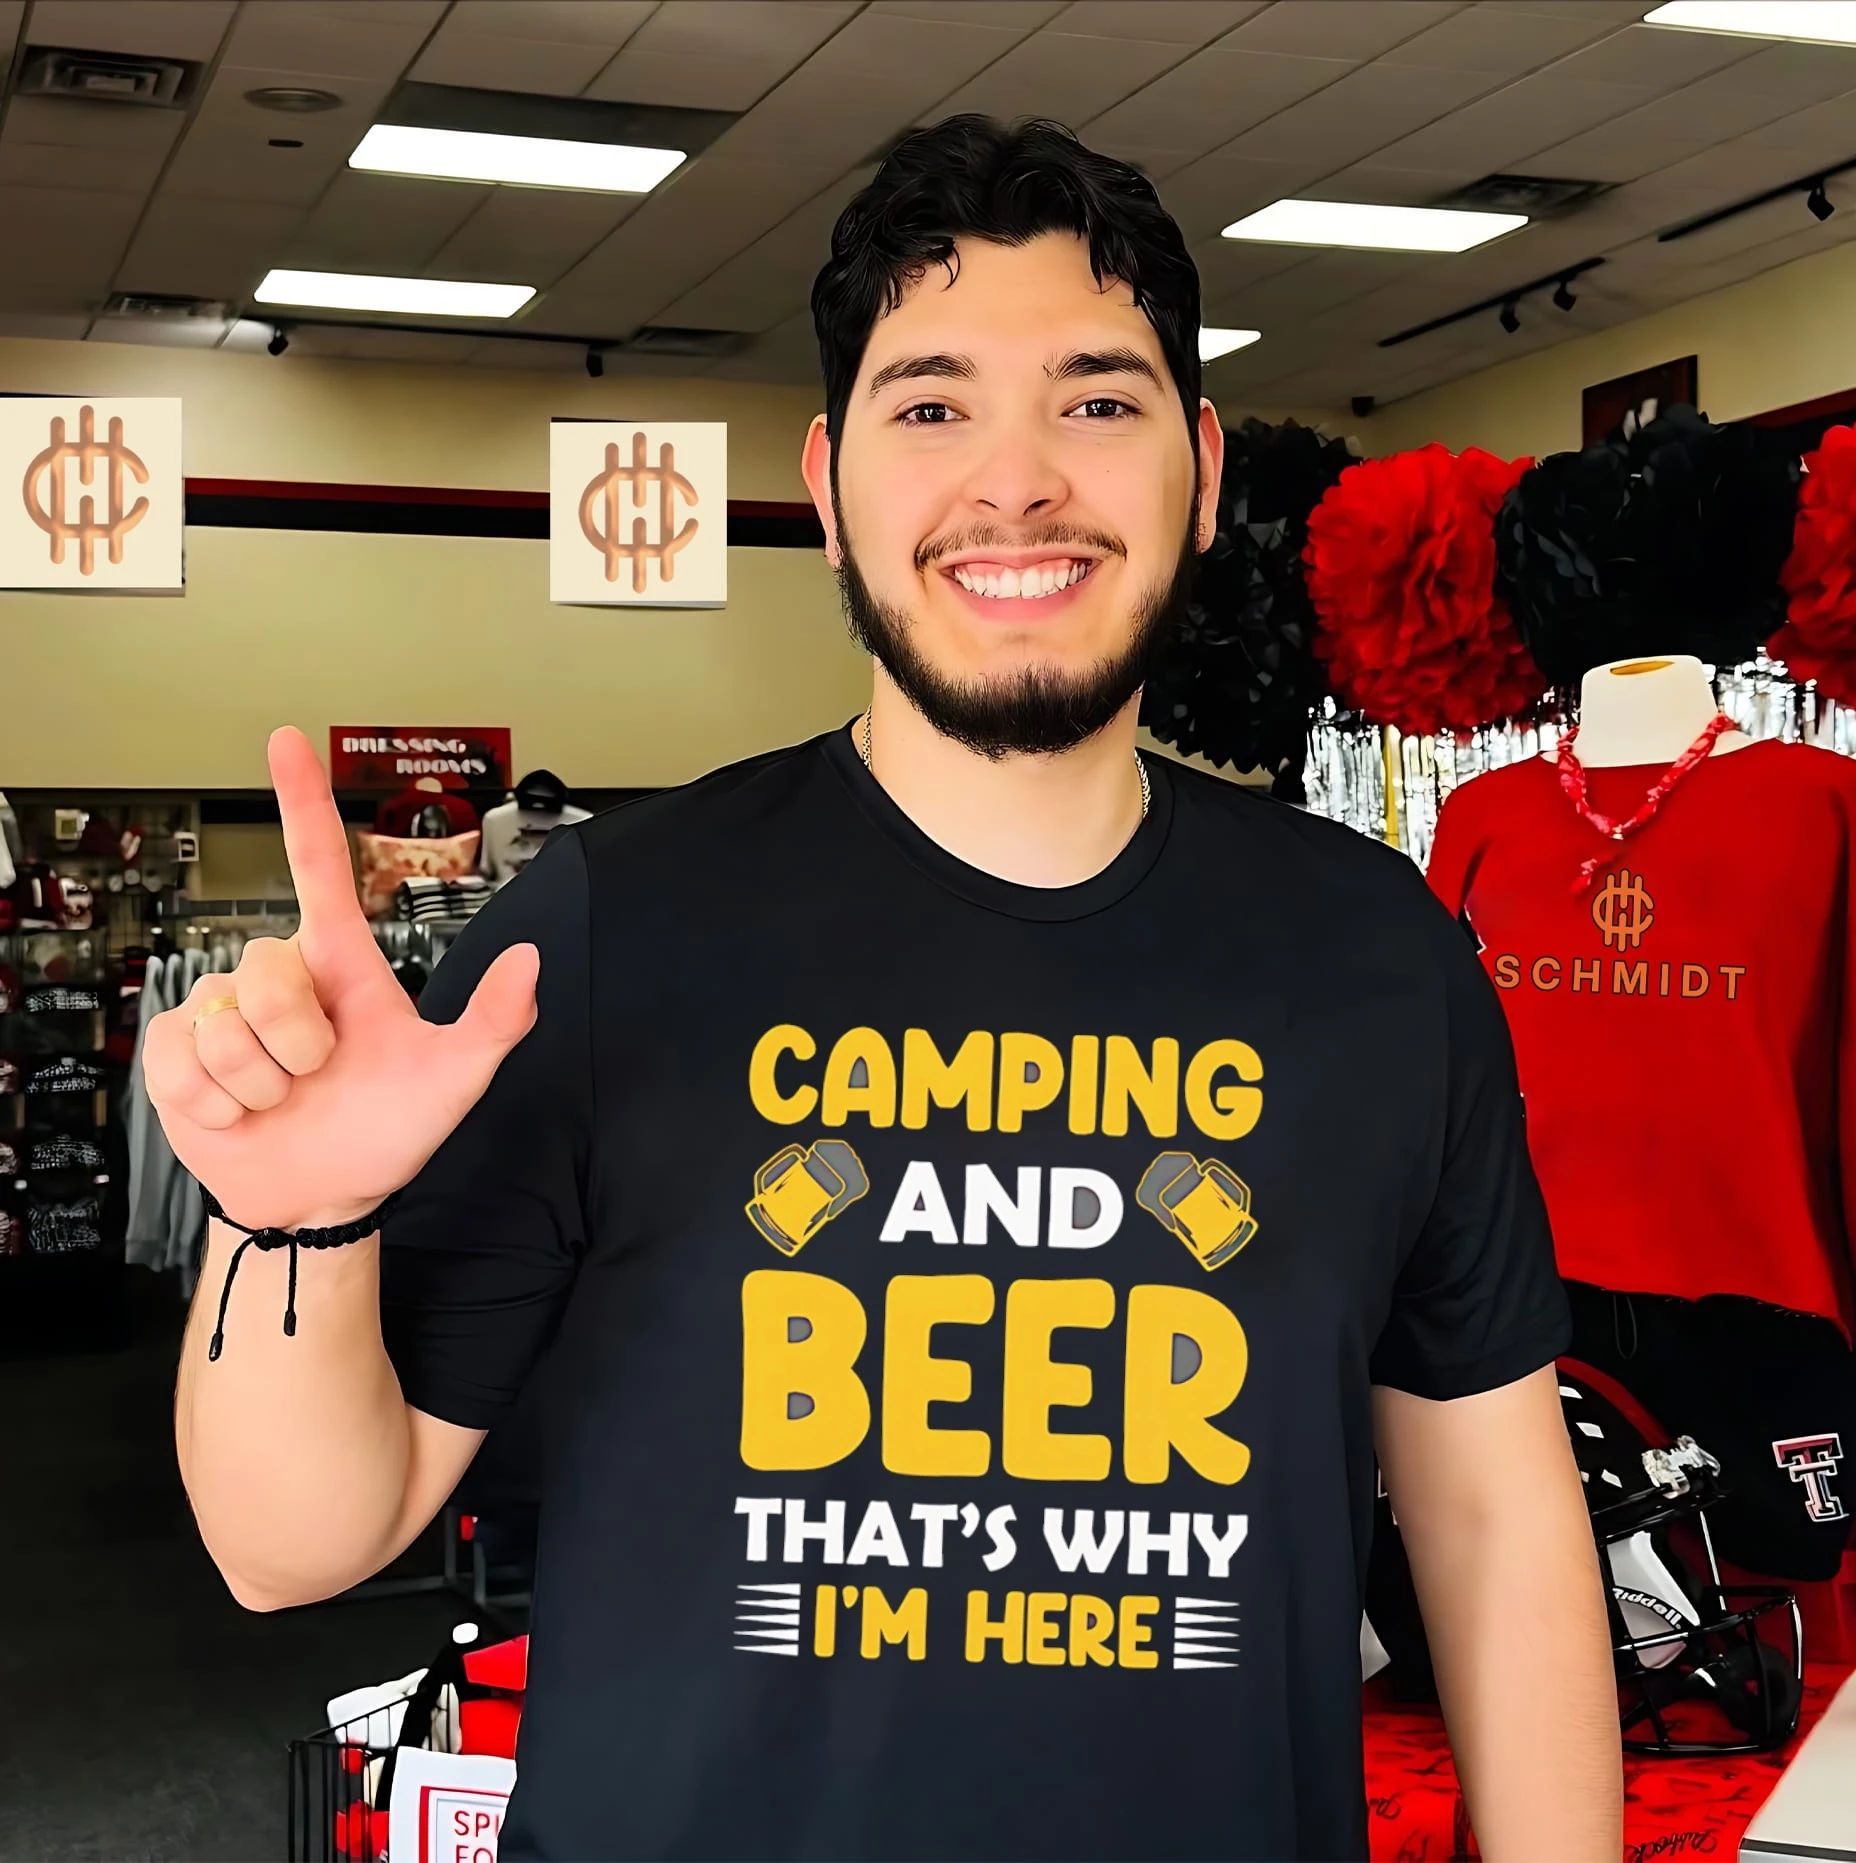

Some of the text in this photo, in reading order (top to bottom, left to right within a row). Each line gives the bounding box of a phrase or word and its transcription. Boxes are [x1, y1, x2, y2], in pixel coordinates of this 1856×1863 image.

[341, 737, 467, 754] DRESSING
[396, 758, 487, 776] ROOMS
[1494, 954, 1746, 1000] SCHMIDT
[749, 1024, 1264, 1140] CAMPING
[879, 1160, 1124, 1249] AND
[740, 1269, 1251, 1485] BEER
[734, 1496, 1249, 1578] THAT'S WHY
[813, 1583, 1161, 1669] I'M HERE
